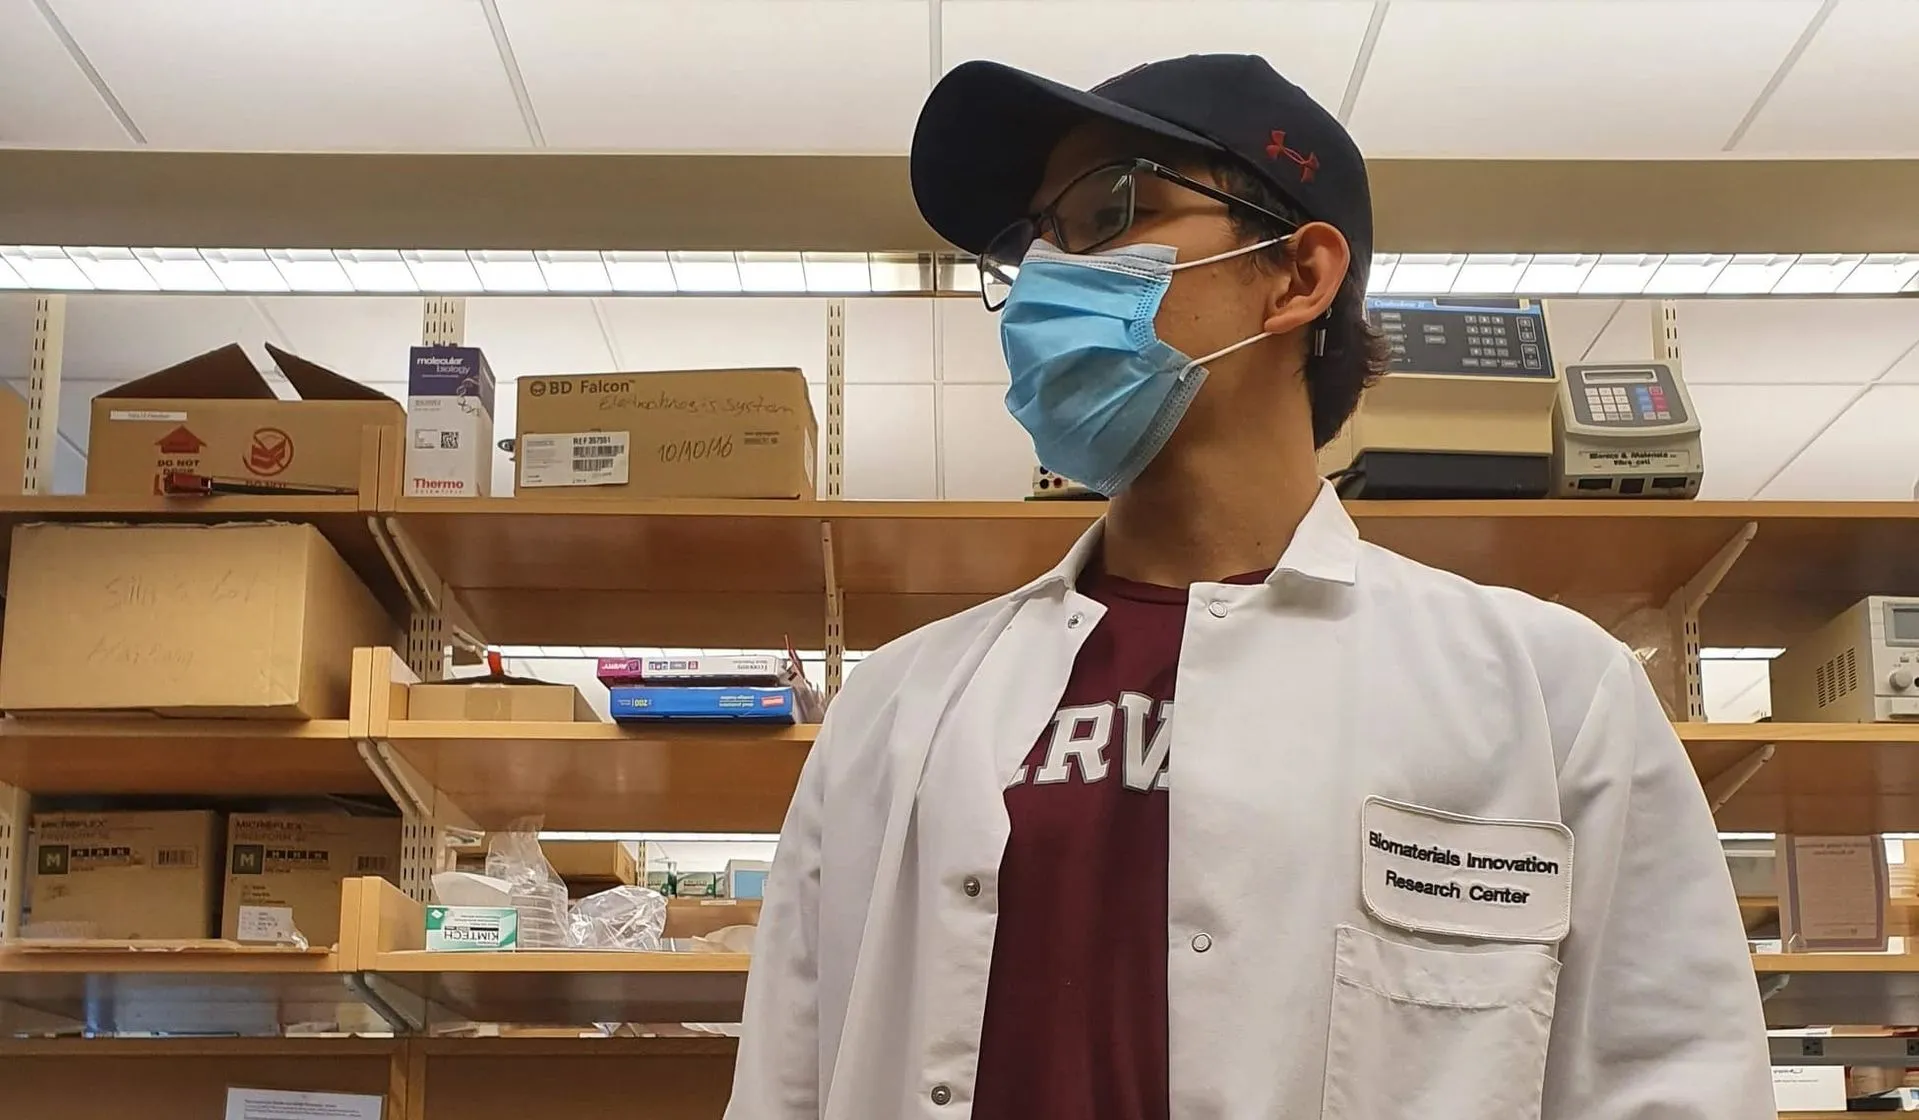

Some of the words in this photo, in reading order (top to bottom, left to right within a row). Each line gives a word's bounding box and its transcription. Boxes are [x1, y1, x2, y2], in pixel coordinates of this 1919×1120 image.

[416, 355, 464, 365] molecular
[436, 364, 471, 375] biology
[549, 380, 572, 396] BD
[157, 459, 173, 468] DO
[177, 459, 200, 468] NOT
[413, 477, 464, 489] Thermo
[1002, 691, 1174, 794] RV
[1368, 830, 1461, 868] Biomaterials
[1466, 852, 1560, 875] Innovation
[46, 853, 61, 867] M
[239, 853, 255, 867] M
[1385, 869, 1461, 900] Research
[1468, 885, 1531, 905] Center
[443, 930, 500, 942] KIMTECH
